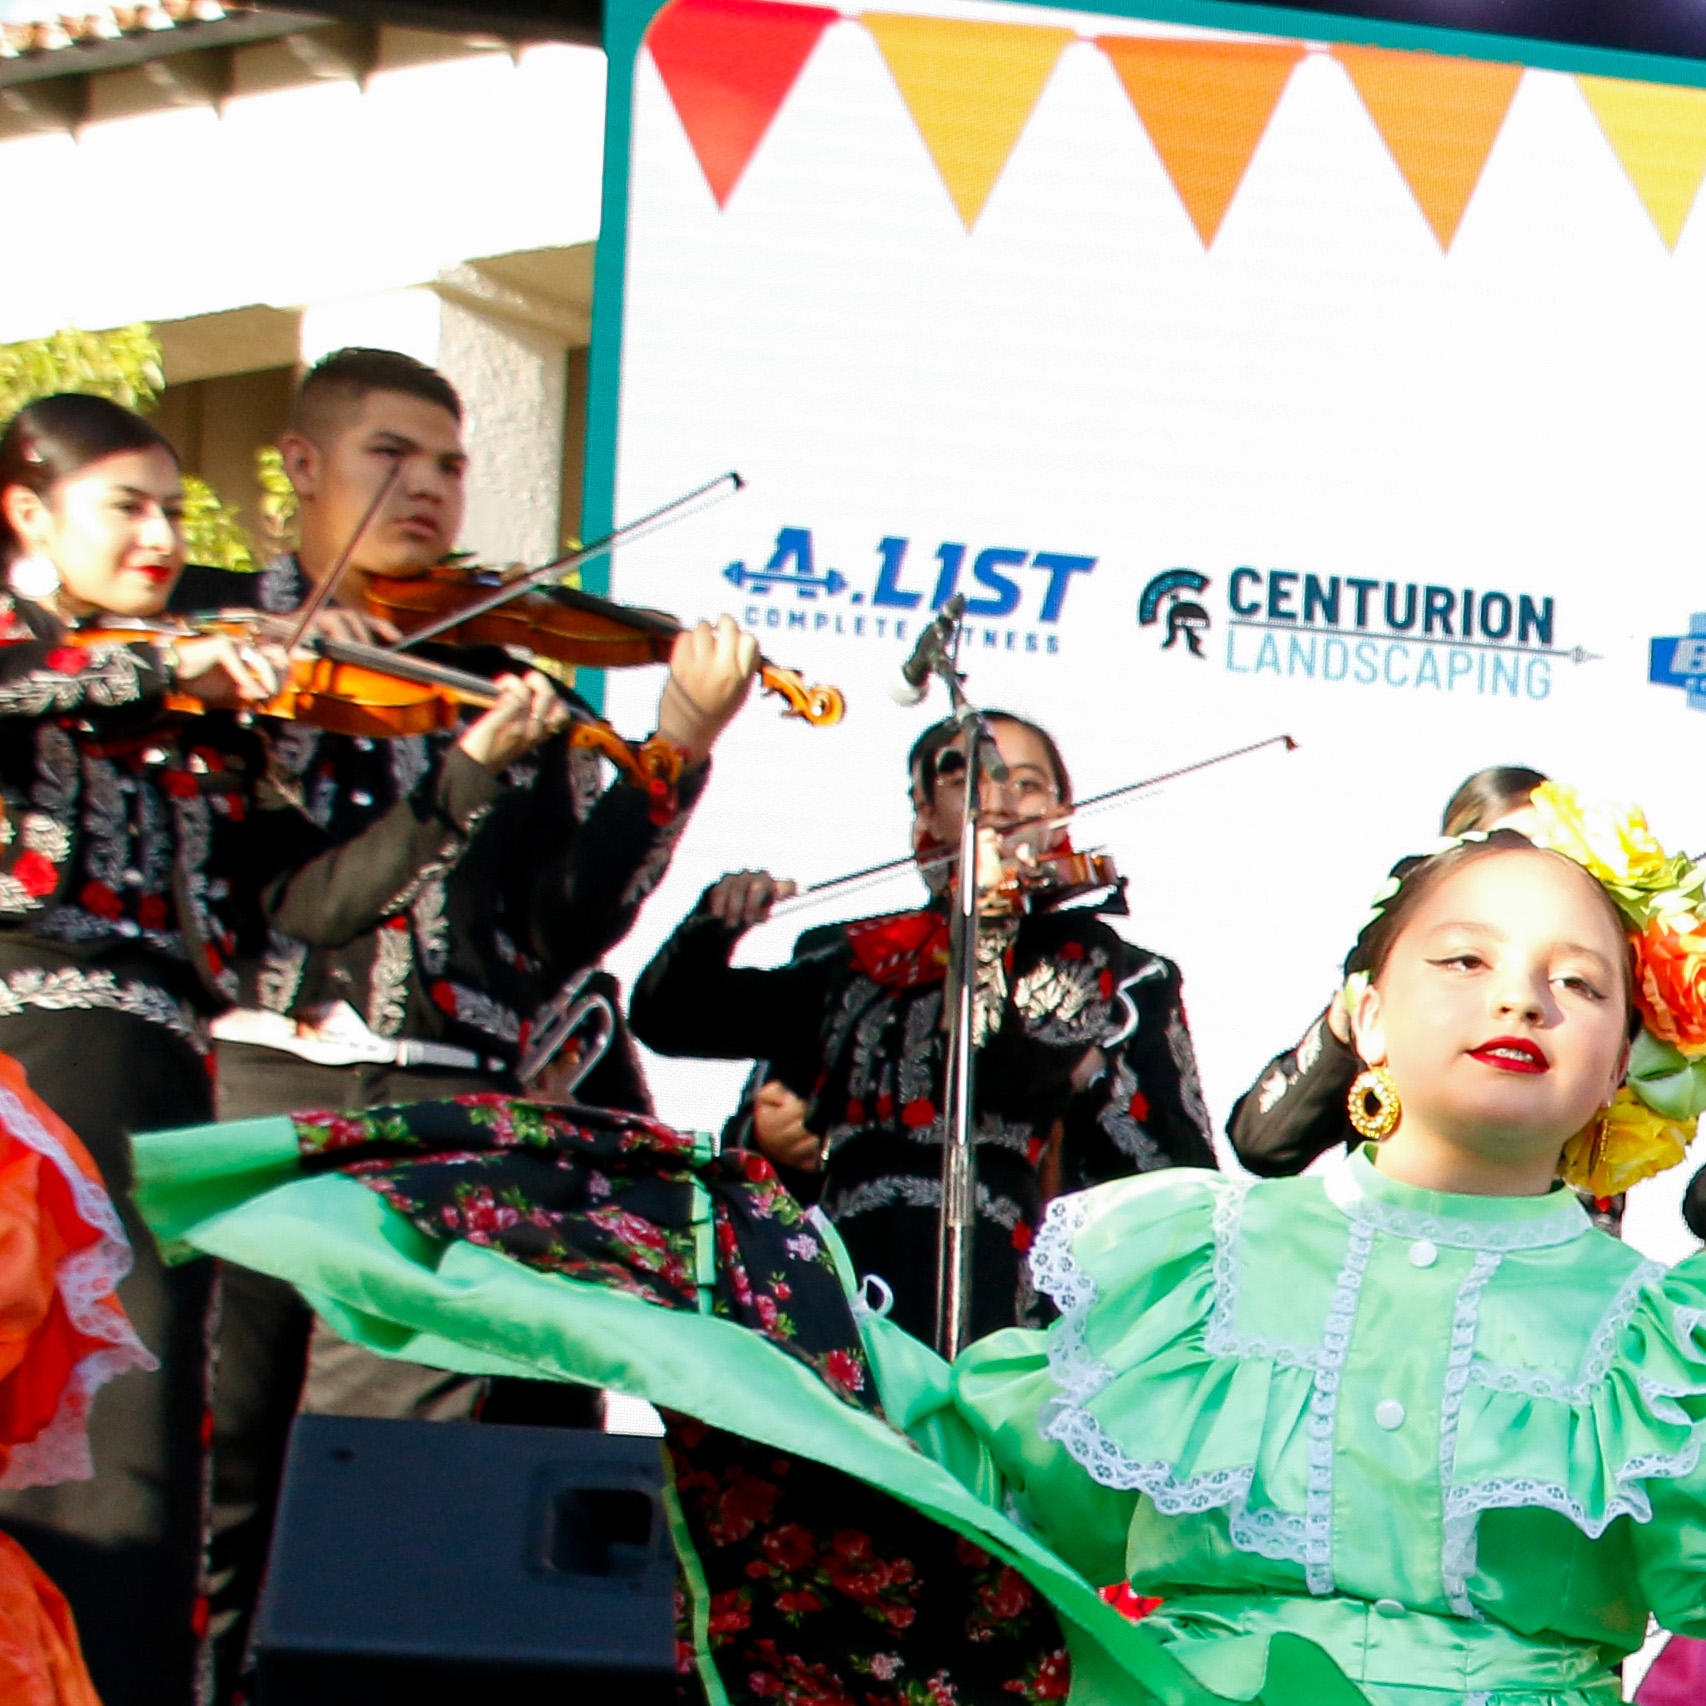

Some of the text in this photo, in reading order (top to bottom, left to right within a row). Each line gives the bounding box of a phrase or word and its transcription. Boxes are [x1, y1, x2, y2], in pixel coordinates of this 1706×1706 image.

[744, 606, 907, 640] COMPLETE
[1228, 566, 1555, 645] CENTURION
[1226, 629, 1552, 701] LANDSCAPING
